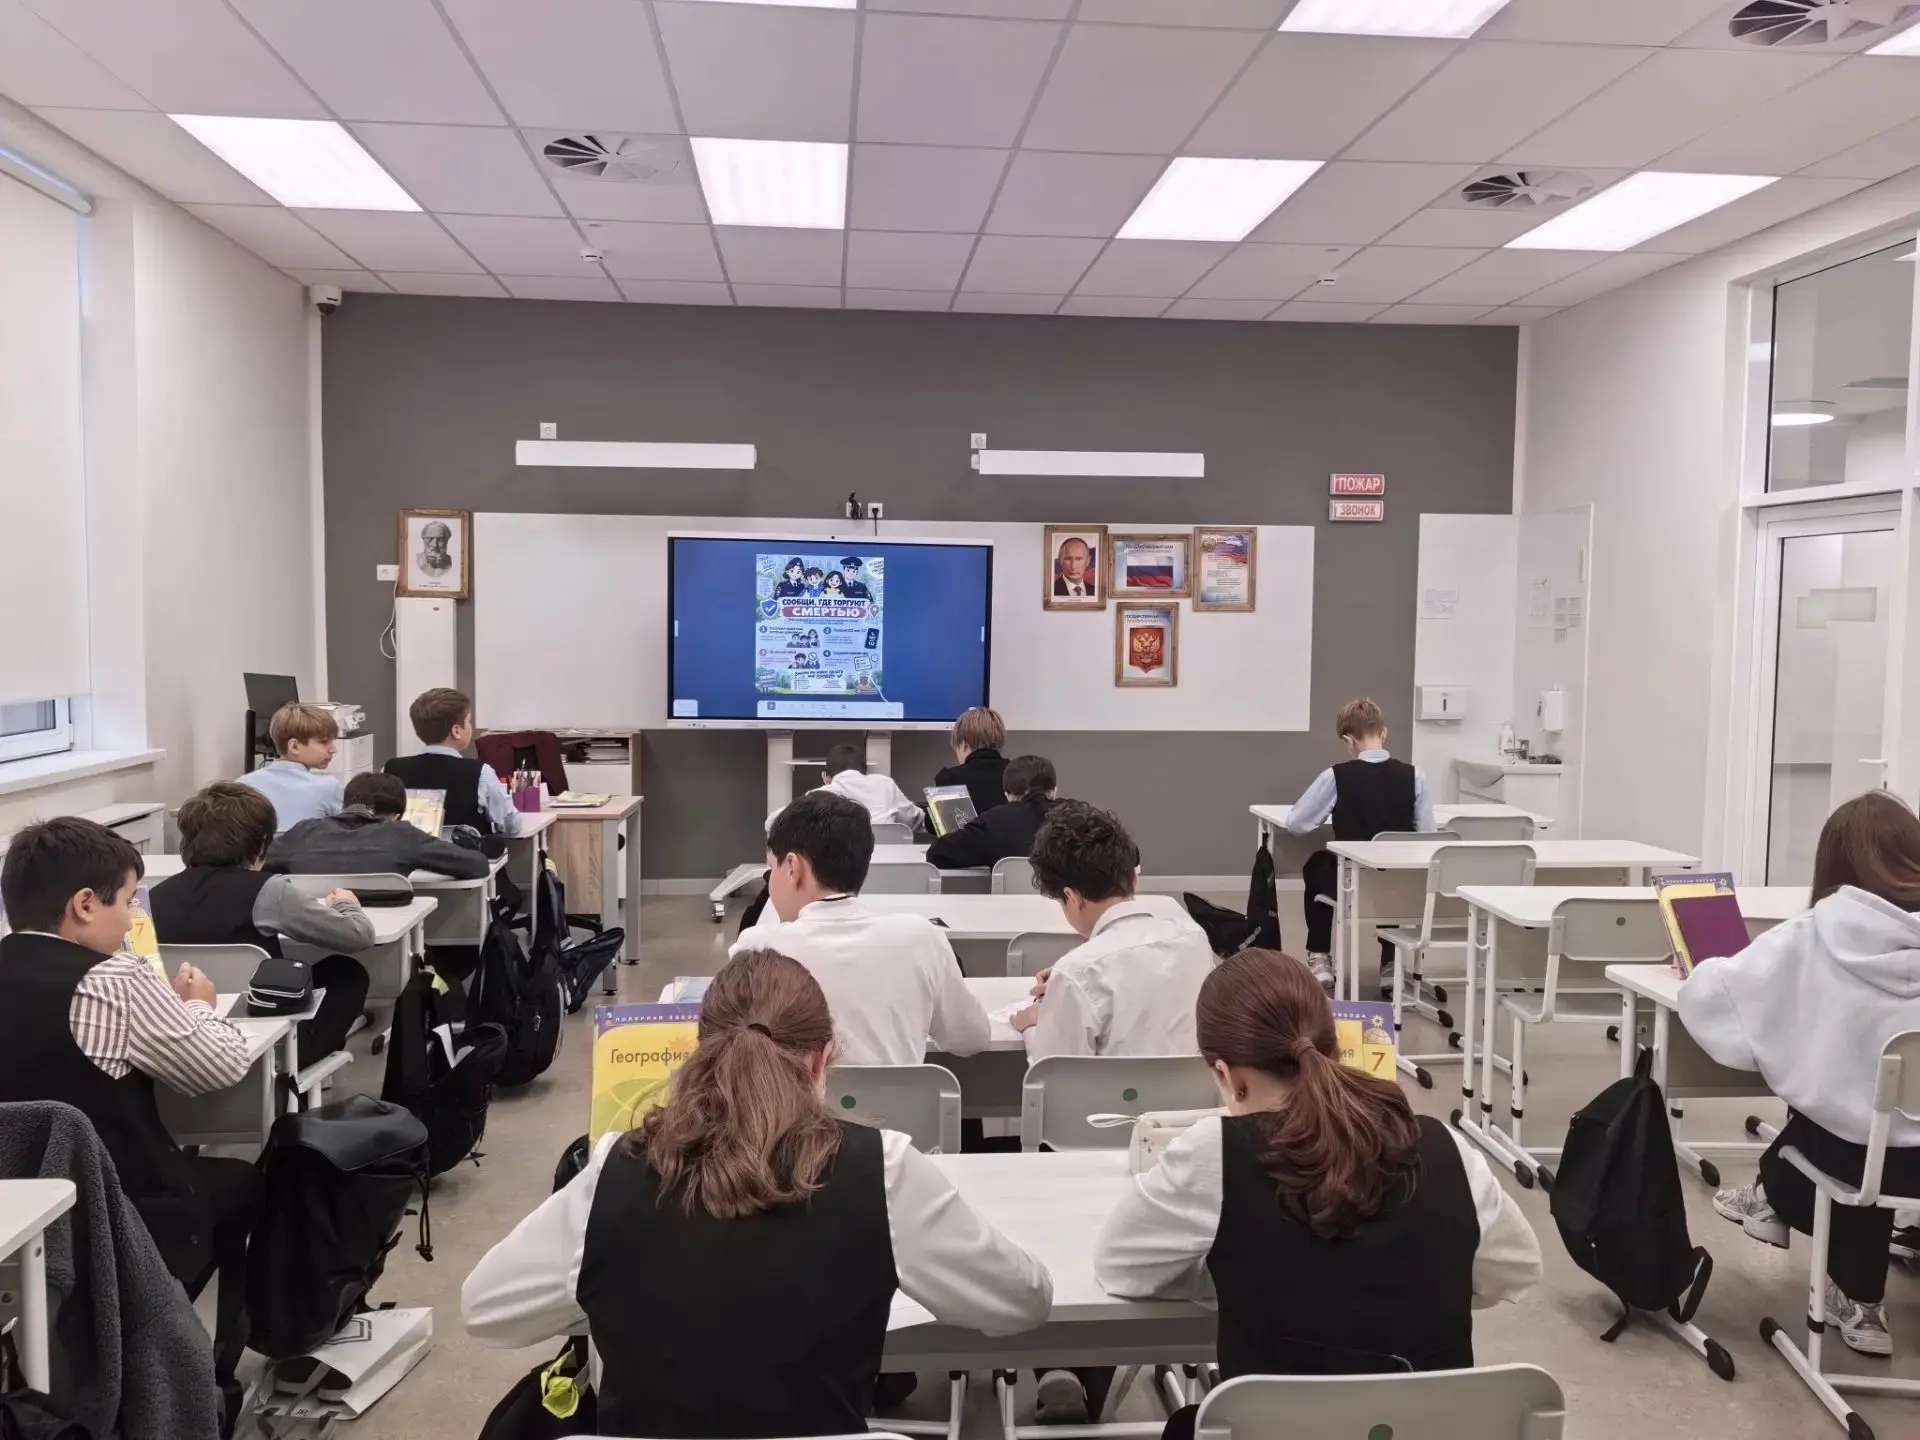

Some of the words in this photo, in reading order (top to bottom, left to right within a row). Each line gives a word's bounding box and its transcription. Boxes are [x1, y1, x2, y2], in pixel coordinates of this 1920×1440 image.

[1338, 477, 1380, 491] ПОЖАР
[1340, 504, 1376, 516] ЗВОНОК
[834, 599, 866, 607] ТОРГУЮТ
[792, 607, 860, 617] СМЕРТЬЮ
[135, 922, 145, 937] 7
[1371, 1051, 1386, 1072] 7
